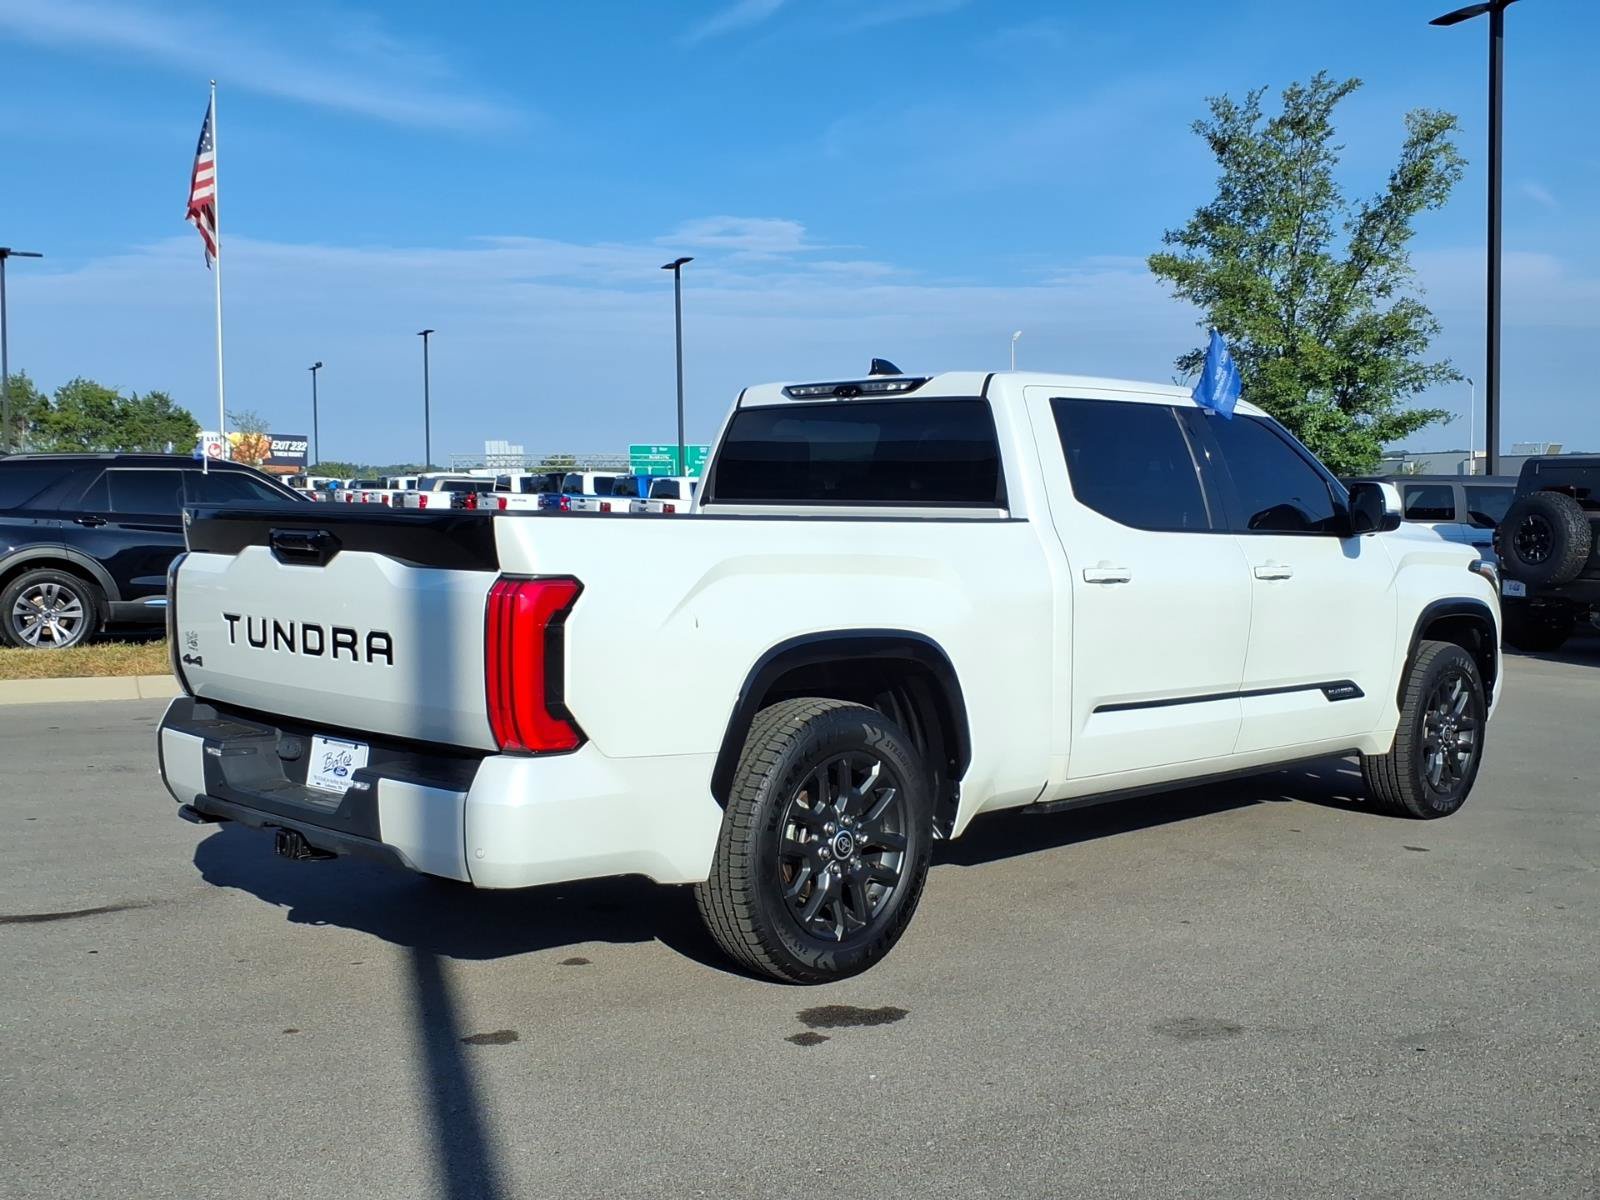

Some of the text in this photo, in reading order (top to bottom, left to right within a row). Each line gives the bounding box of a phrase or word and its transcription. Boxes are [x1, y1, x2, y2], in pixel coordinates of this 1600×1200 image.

[271, 440, 308, 451] EXIT 232
[222, 613, 394, 666] TUNDRA
